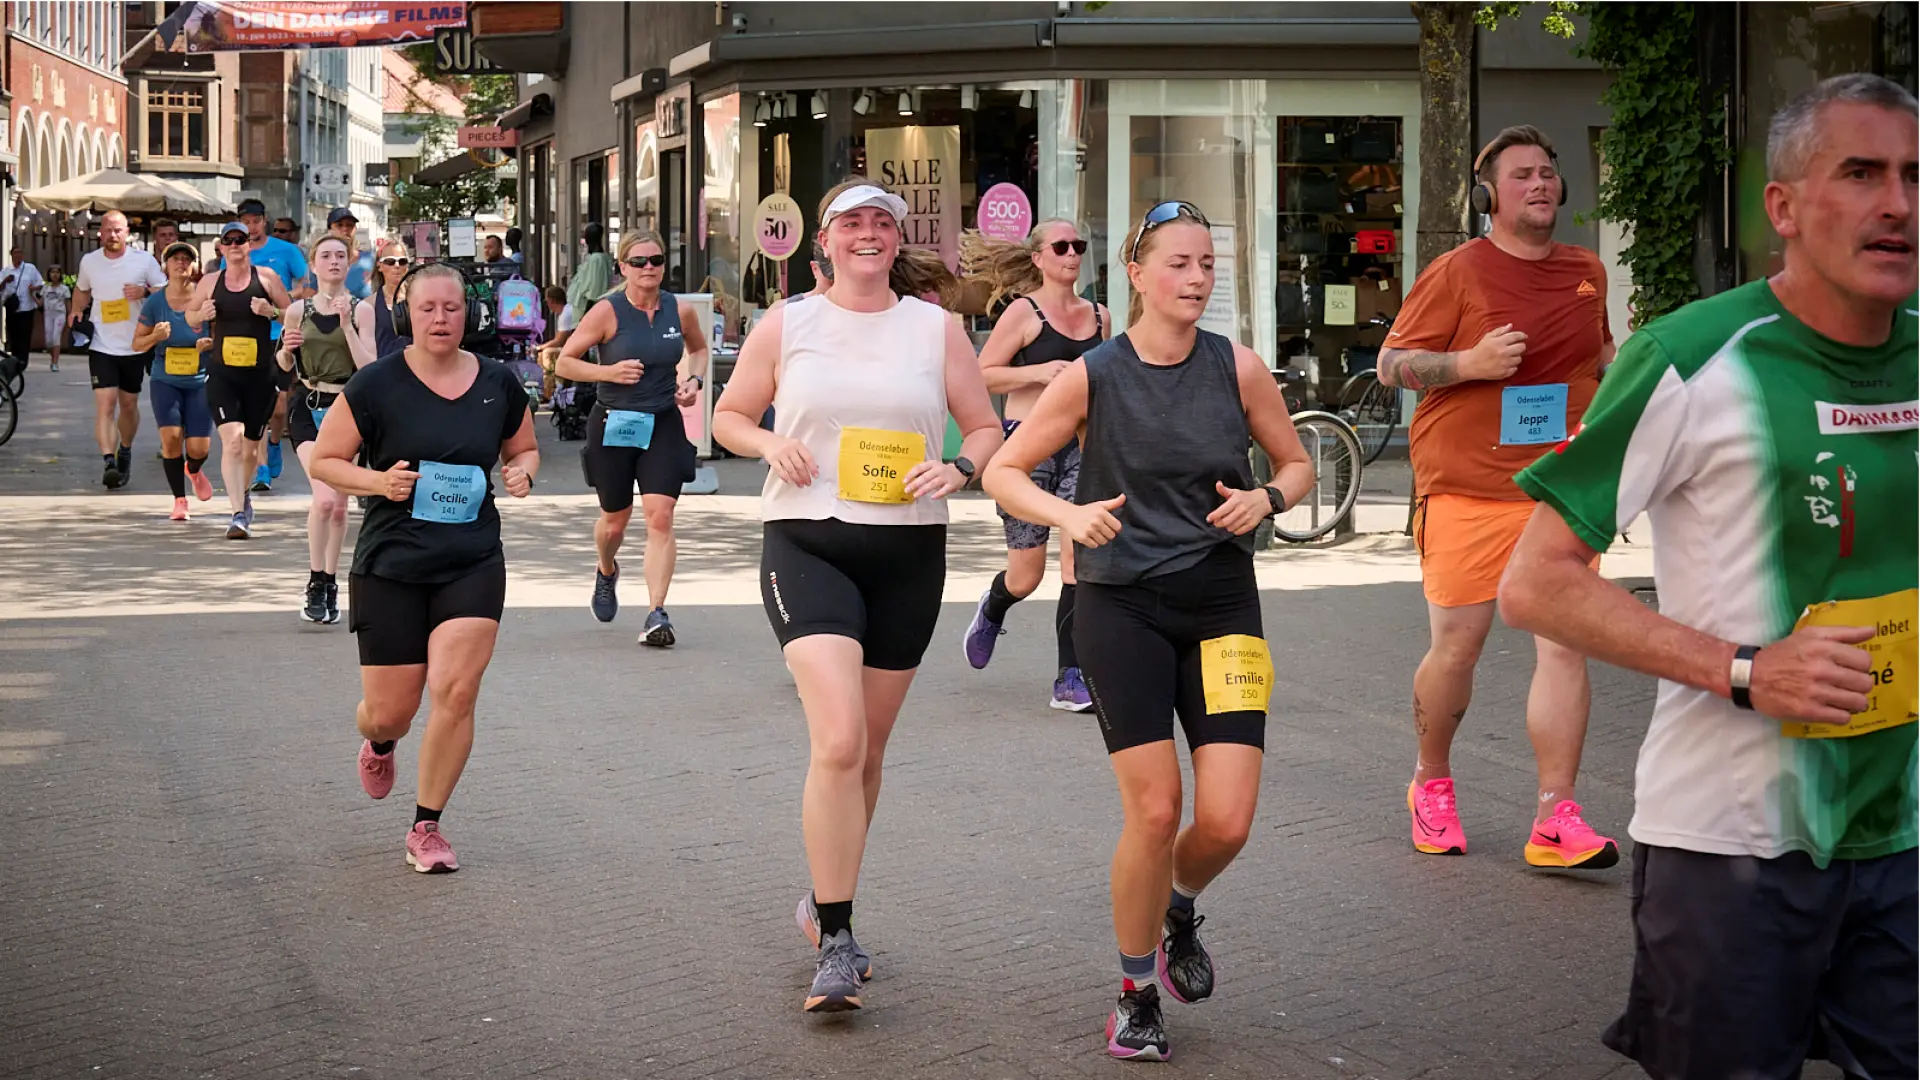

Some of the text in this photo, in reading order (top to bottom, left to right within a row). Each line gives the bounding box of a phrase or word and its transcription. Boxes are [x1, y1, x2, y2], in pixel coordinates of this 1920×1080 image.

[233, 6, 463, 29] DEN DANSKE FILMS
[468, 131, 506, 142] PIECES
[881, 159, 942, 186] SALE
[768, 203, 788, 212] SALE
[900, 219, 941, 245] ALE
[1518, 414, 1549, 427] Jeppe
[1528, 427, 1542, 435] 483
[860, 440, 910, 455] Odenseløbet
[862, 464, 898, 479] Sofie
[870, 482, 889, 492] 251
[431, 491, 469, 504] Cecilie
[442, 506, 456, 515] 141
[1221, 649, 1264, 660] Odenseløbet
[1225, 671, 1265, 686] Emilie
[1241, 689, 1259, 699] 250
